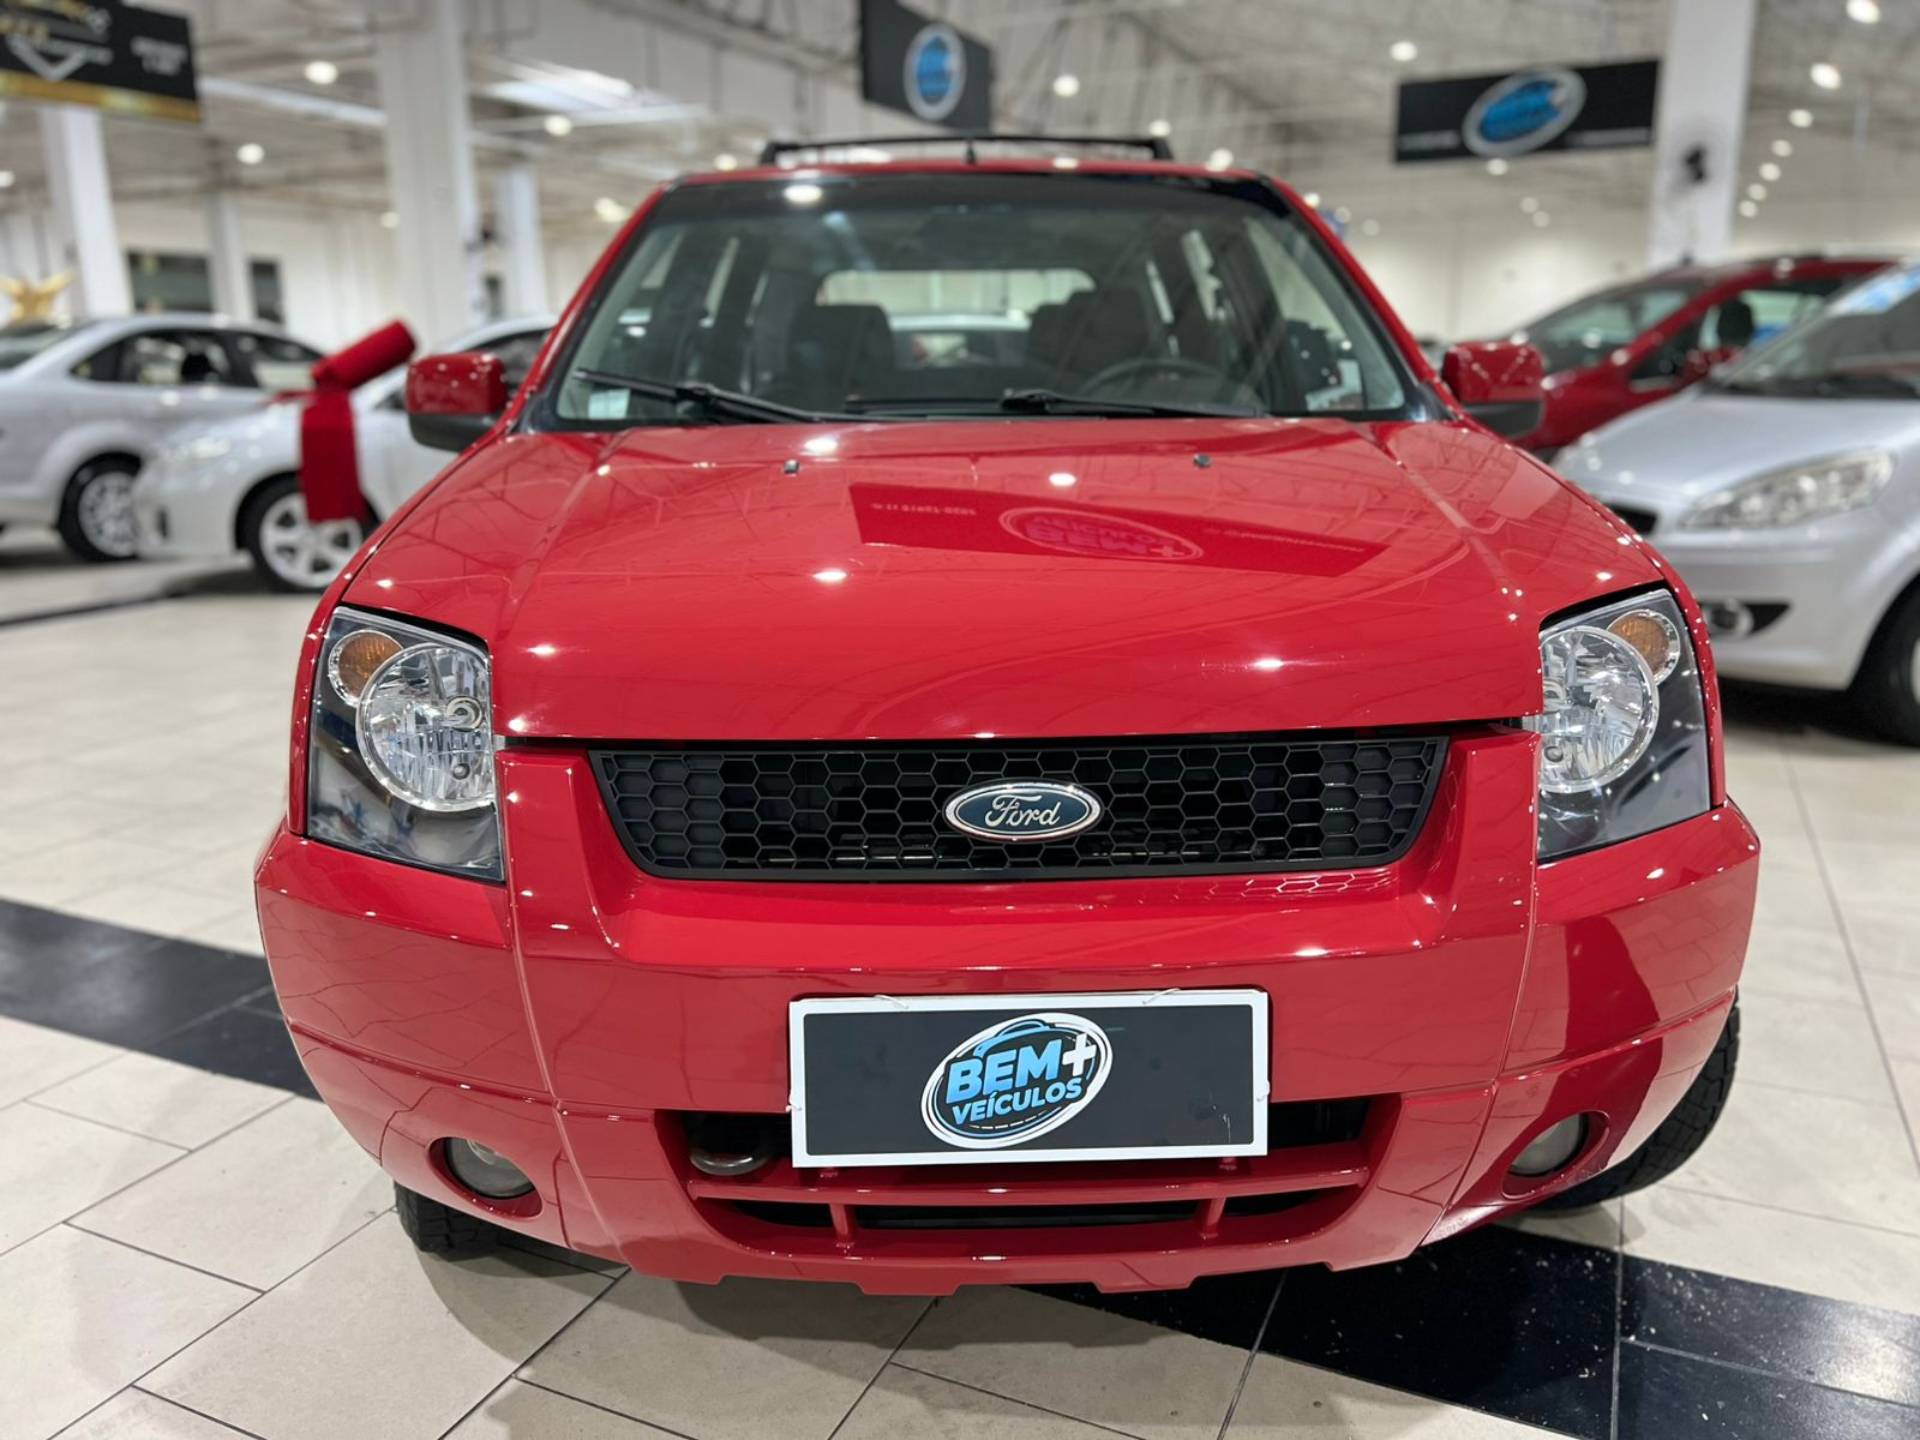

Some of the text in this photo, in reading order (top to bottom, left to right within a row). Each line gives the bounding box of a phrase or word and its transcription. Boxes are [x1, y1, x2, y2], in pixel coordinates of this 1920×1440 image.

[984, 794, 1062, 827] Ford
[946, 1032, 1097, 1104] BEM+
[952, 1077, 1082, 1125] VEÍCULOS
